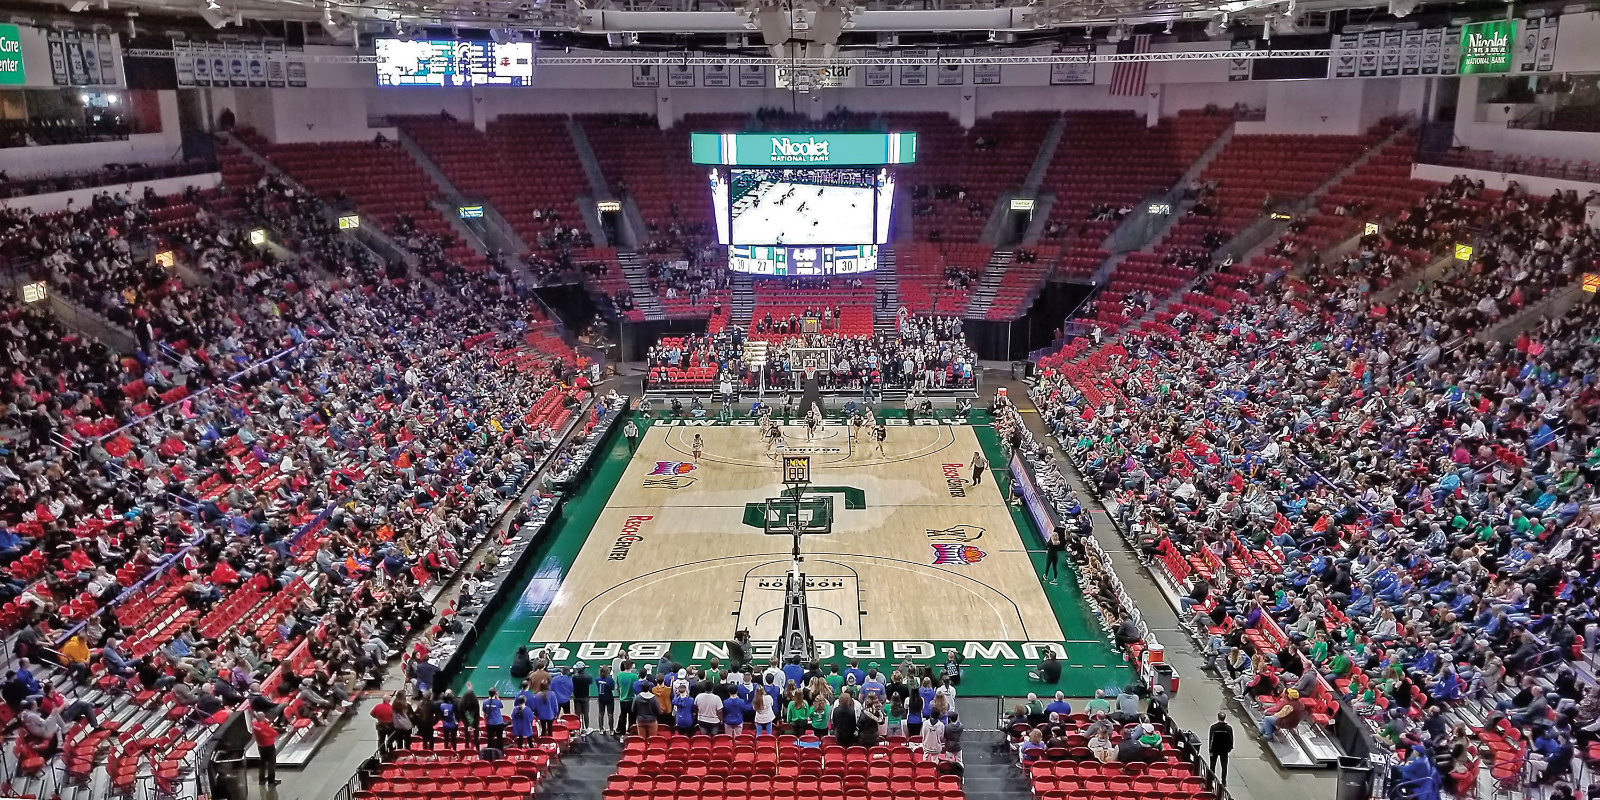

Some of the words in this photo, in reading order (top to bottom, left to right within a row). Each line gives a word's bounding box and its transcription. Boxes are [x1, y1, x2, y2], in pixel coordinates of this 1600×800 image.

[0, 36, 19, 53] Care
[1466, 31, 1508, 56] Nicolet
[1466, 57, 1490, 65] NATIONAL
[1491, 56, 1506, 64] BANK
[770, 136, 830, 156] Nicolet
[757, 261, 767, 272] 27
[841, 260, 853, 272] 30
[527, 641, 672, 662] BAY
